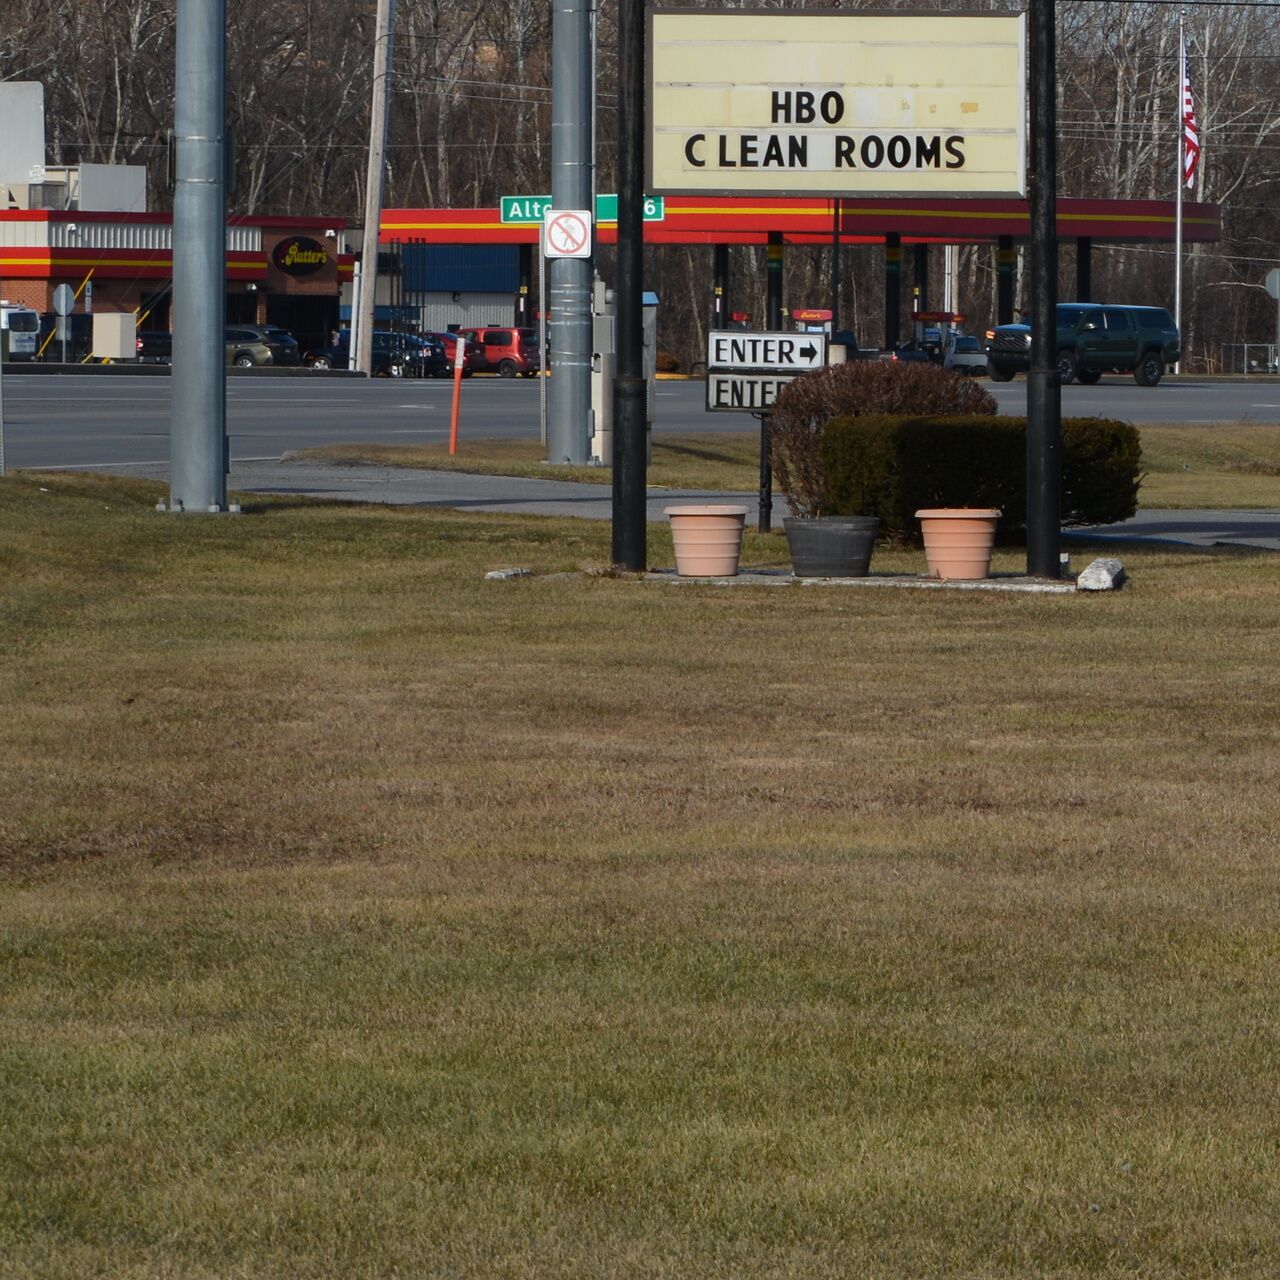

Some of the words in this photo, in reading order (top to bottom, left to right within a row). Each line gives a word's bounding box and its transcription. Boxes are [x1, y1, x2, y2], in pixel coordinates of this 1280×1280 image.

[771, 90, 845, 124] HBO
[685, 133, 808, 168] CLEAN
[834, 135, 966, 169] ROOMS
[715, 338, 795, 363] ENTER
